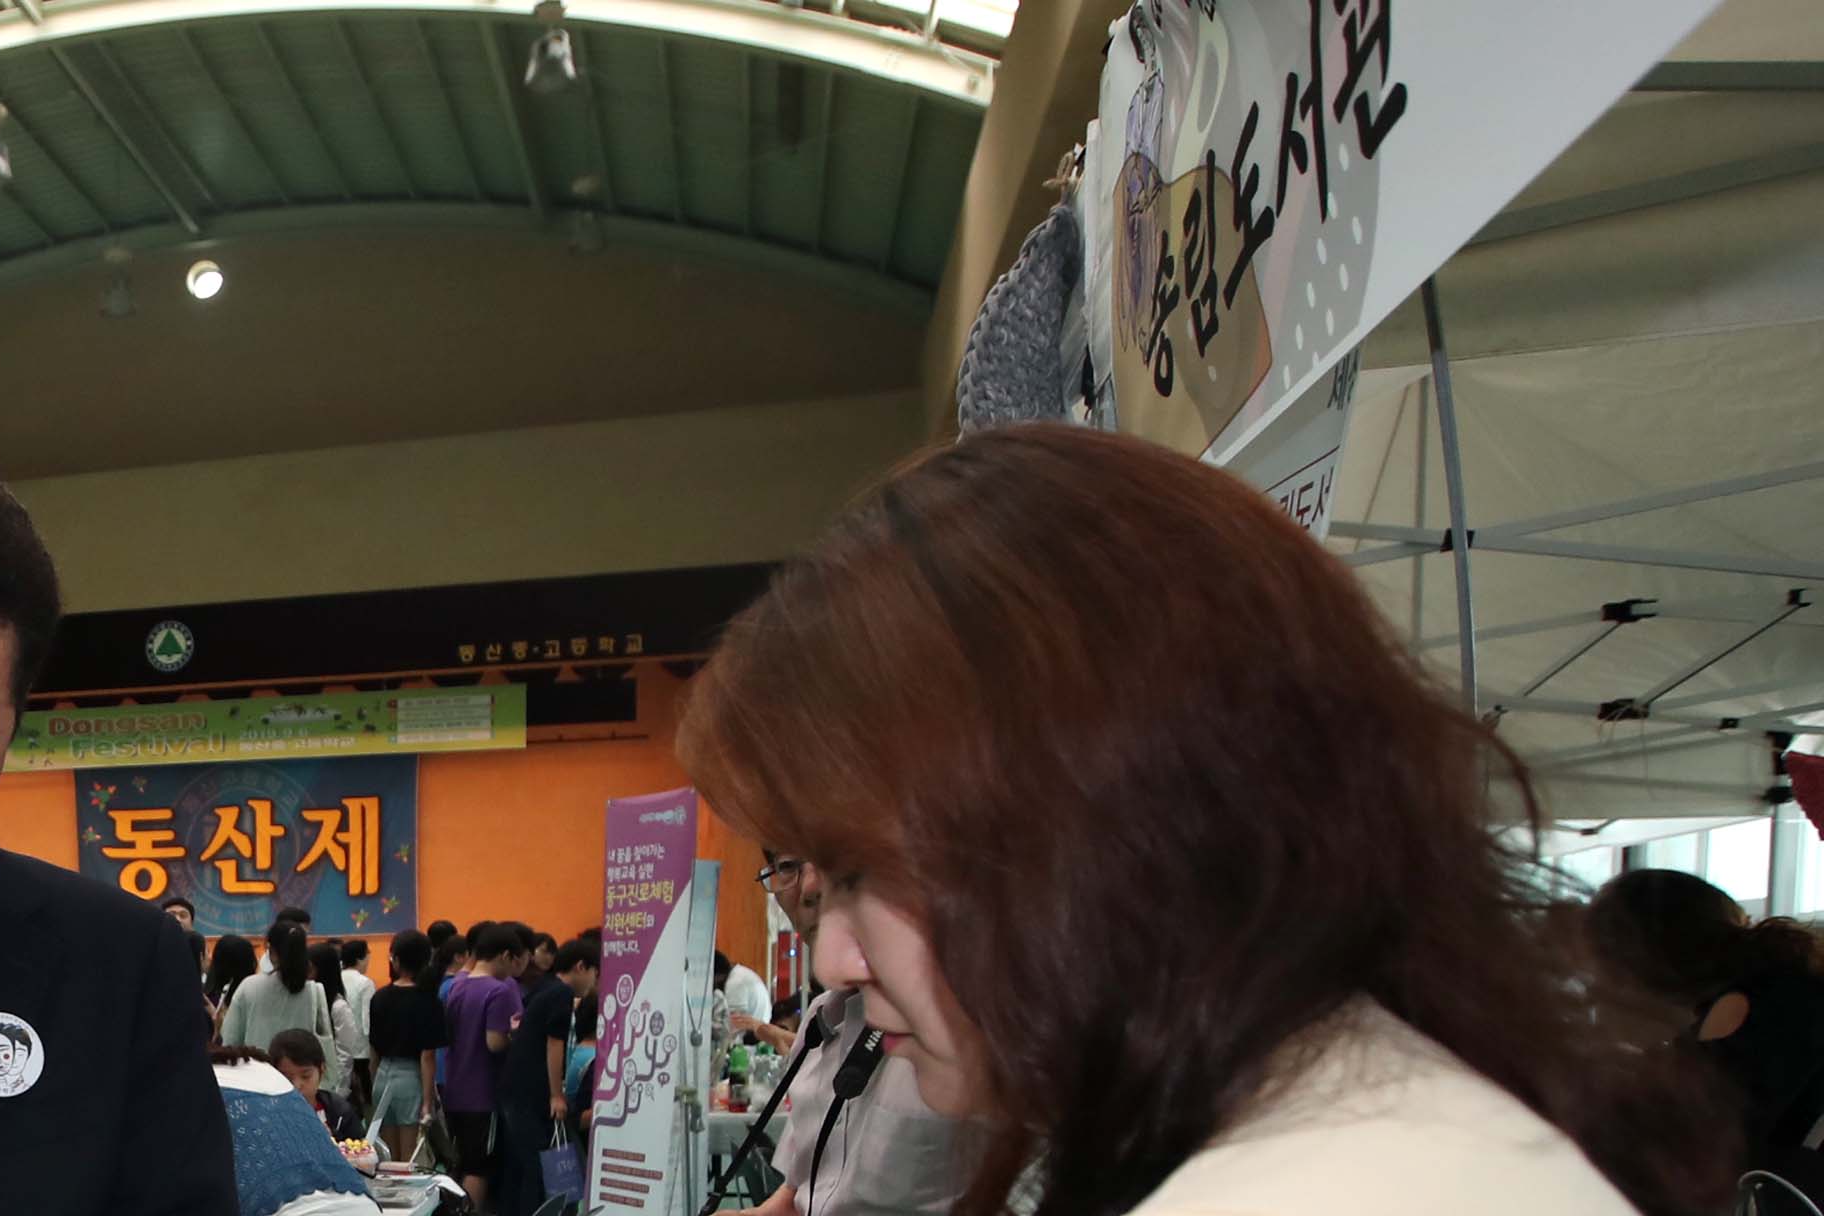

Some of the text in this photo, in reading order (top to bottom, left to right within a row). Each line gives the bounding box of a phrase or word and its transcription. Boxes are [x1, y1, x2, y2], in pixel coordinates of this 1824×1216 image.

[48, 712, 207, 737] Dongsan
[71, 731, 226, 759] Festival
[101, 795, 381, 900] 동산제
[607, 880, 675, 909] 동구진로체험
[863, 1030, 884, 1052] Nik
